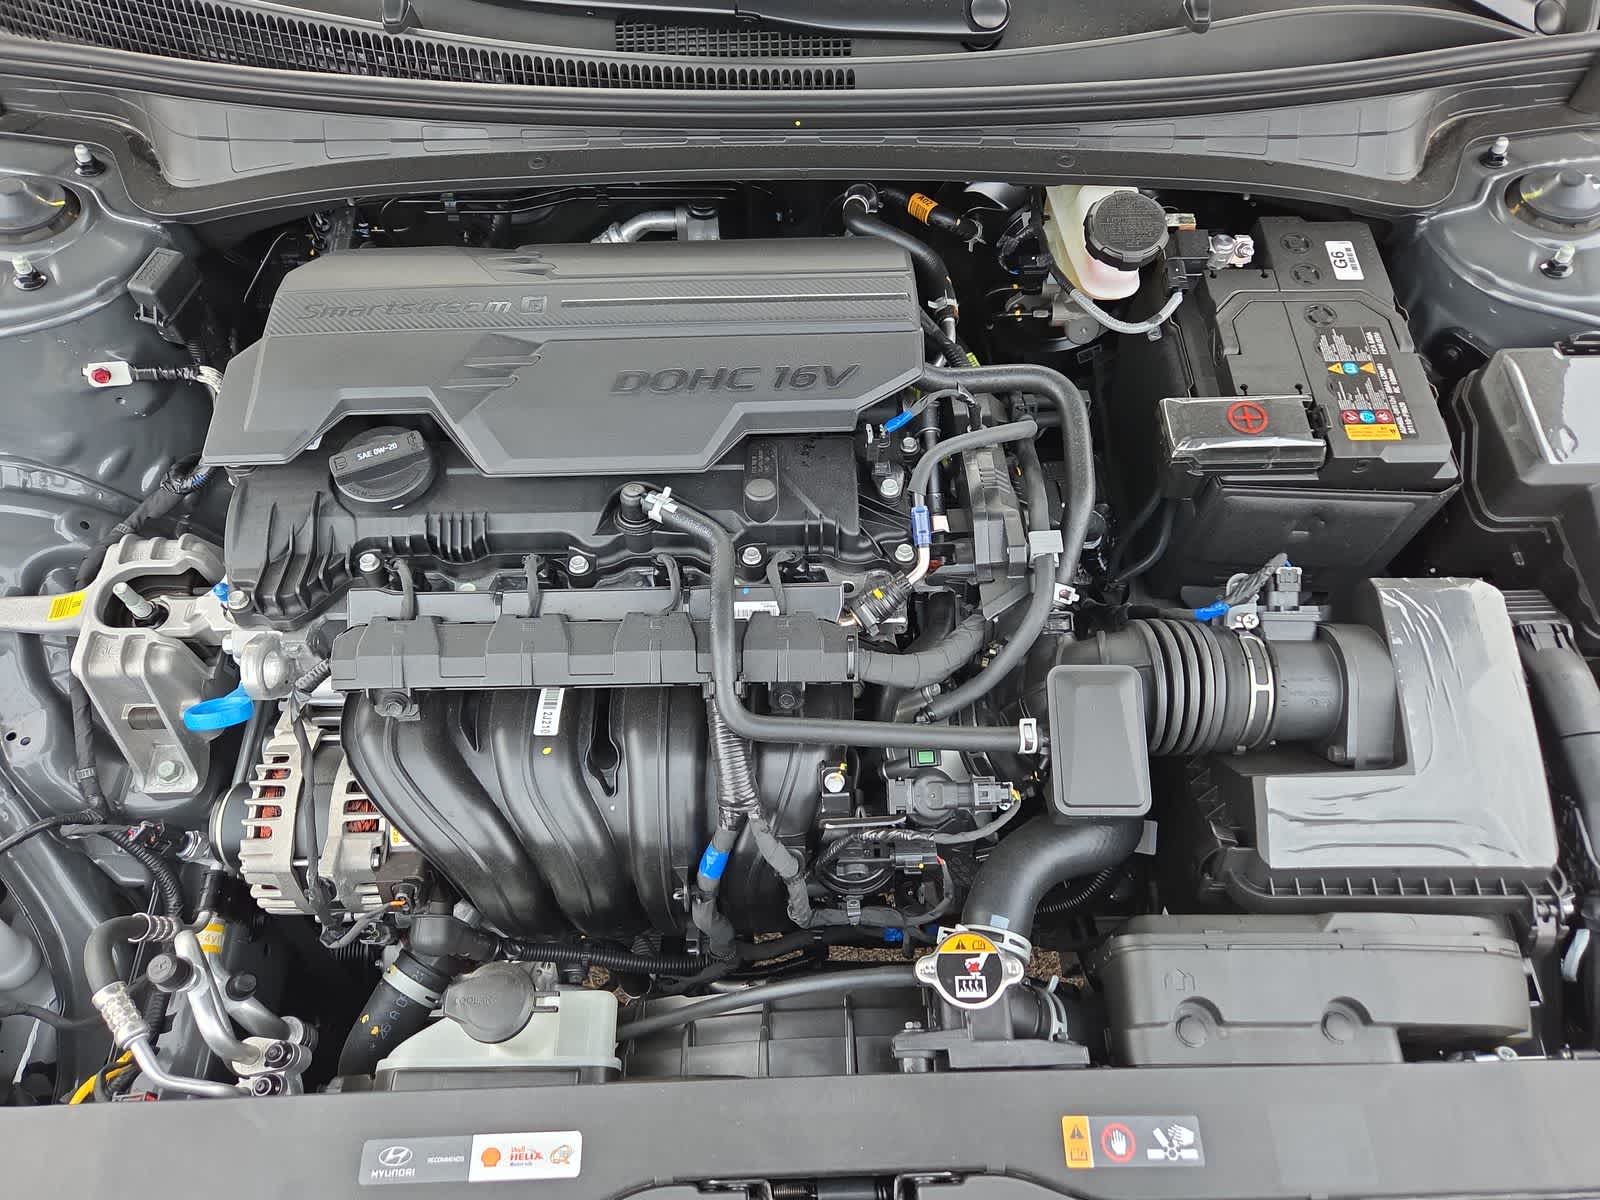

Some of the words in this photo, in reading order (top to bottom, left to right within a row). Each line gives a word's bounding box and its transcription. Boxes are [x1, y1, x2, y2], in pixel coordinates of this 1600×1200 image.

[1331, 251, 1348, 268] G6
[298, 300, 513, 320] Smartstream
[609, 366, 762, 395] DOHC
[773, 363, 862, 391] 16V
[356, 450, 373, 461] SAE
[373, 442, 398, 455] 0W-20
[510, 1152, 544, 1161] HELIX
[370, 1167, 416, 1178] HYUNDAI
